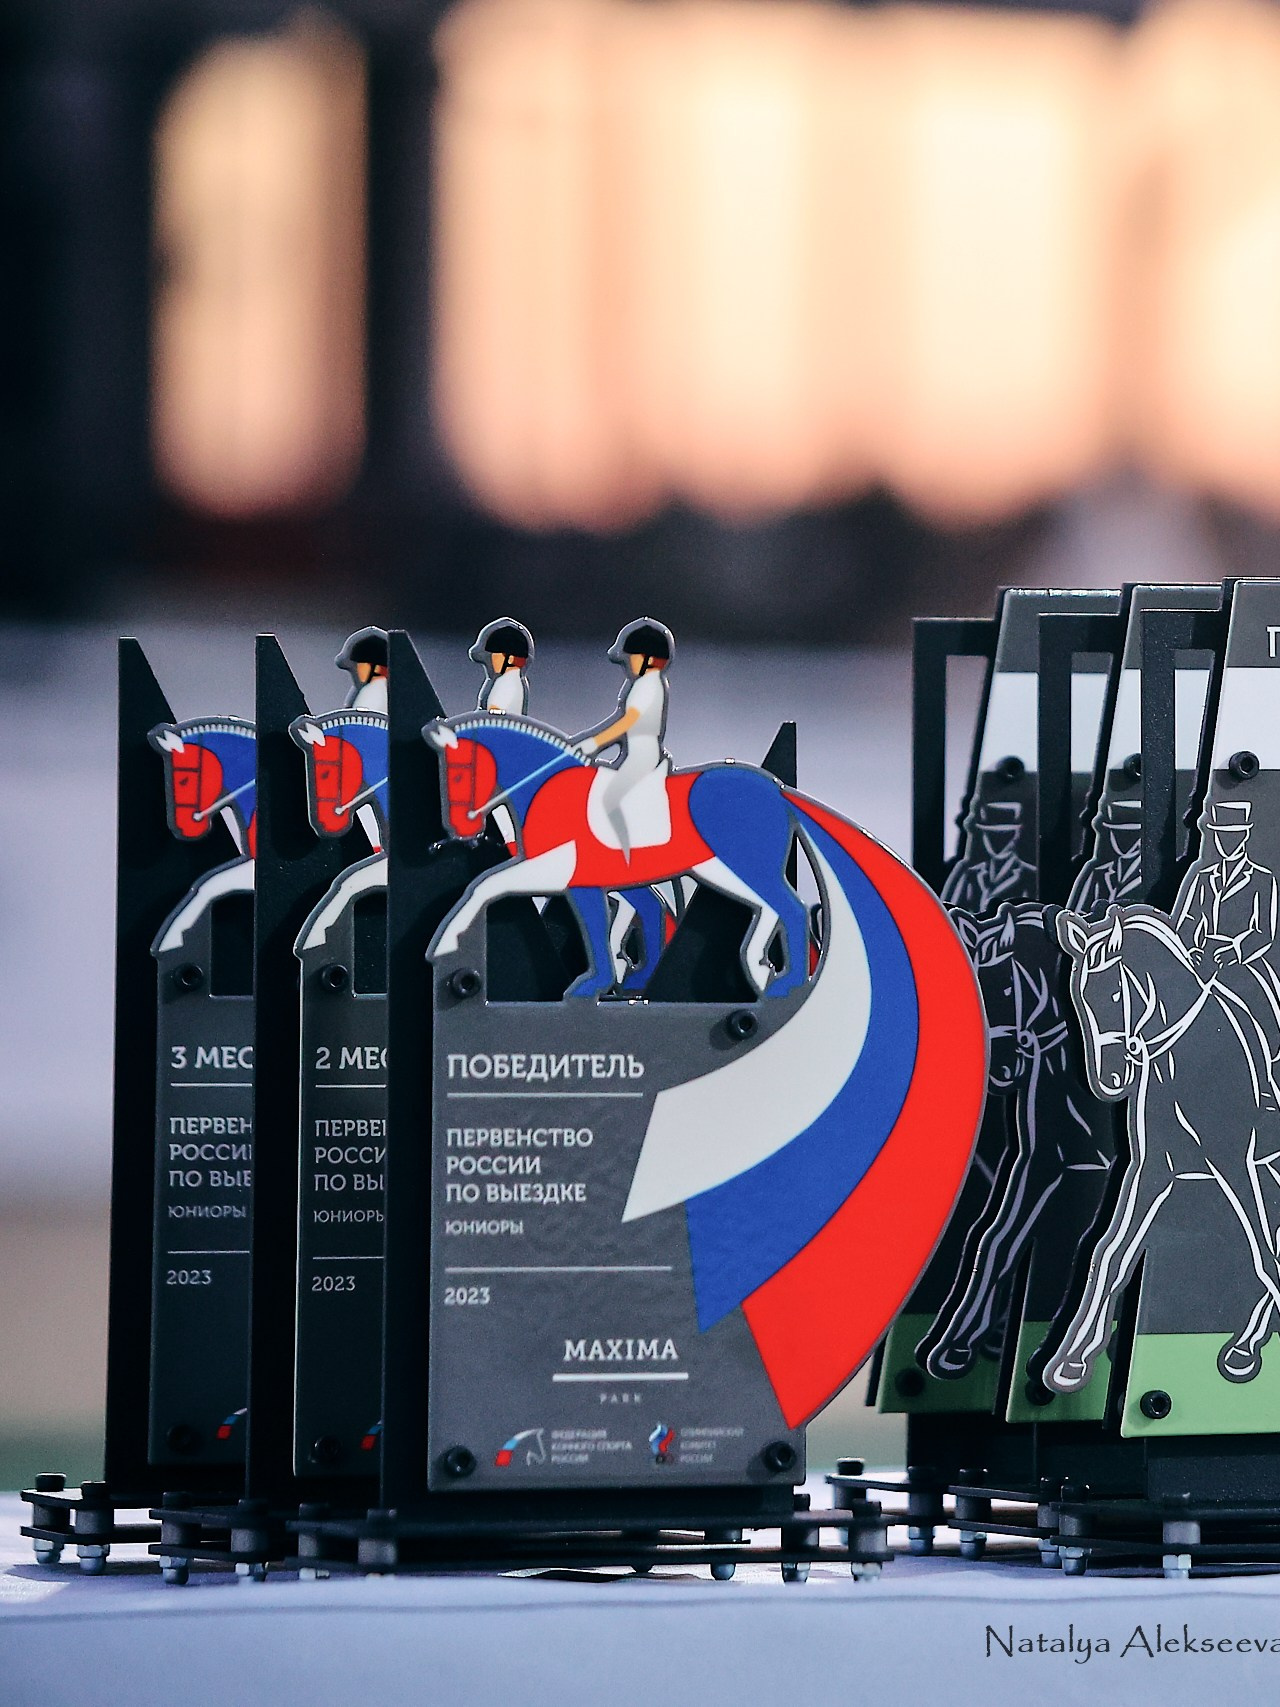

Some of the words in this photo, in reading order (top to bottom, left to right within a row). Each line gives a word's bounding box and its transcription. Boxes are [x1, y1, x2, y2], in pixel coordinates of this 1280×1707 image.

[171, 1046, 187, 1069] 3
[315, 1046, 331, 1070] 2
[447, 1053, 645, 1083] ПОБЕДИТЕЛЬ
[446, 1127, 594, 1148] ПЕРВЕНСТВО
[168, 1143, 252, 1161] РОССИ
[446, 1155, 542, 1176] РОССИИ
[168, 1170, 203, 1188] ПО
[313, 1173, 347, 1192] ПО
[352, 1173, 384, 1191] ВЫ
[445, 1183, 481, 1203] ПО
[486, 1183, 587, 1204] ВЫЕЗДКЕ
[168, 1205, 246, 1218] ЮНИОРЫ
[445, 1219, 524, 1235] ЮНИОРЫ
[166, 1269, 212, 1285] 2023
[311, 1275, 356, 1292] 2023
[444, 1286, 491, 1306] 2023
[563, 1338, 679, 1362] MAXIMA
